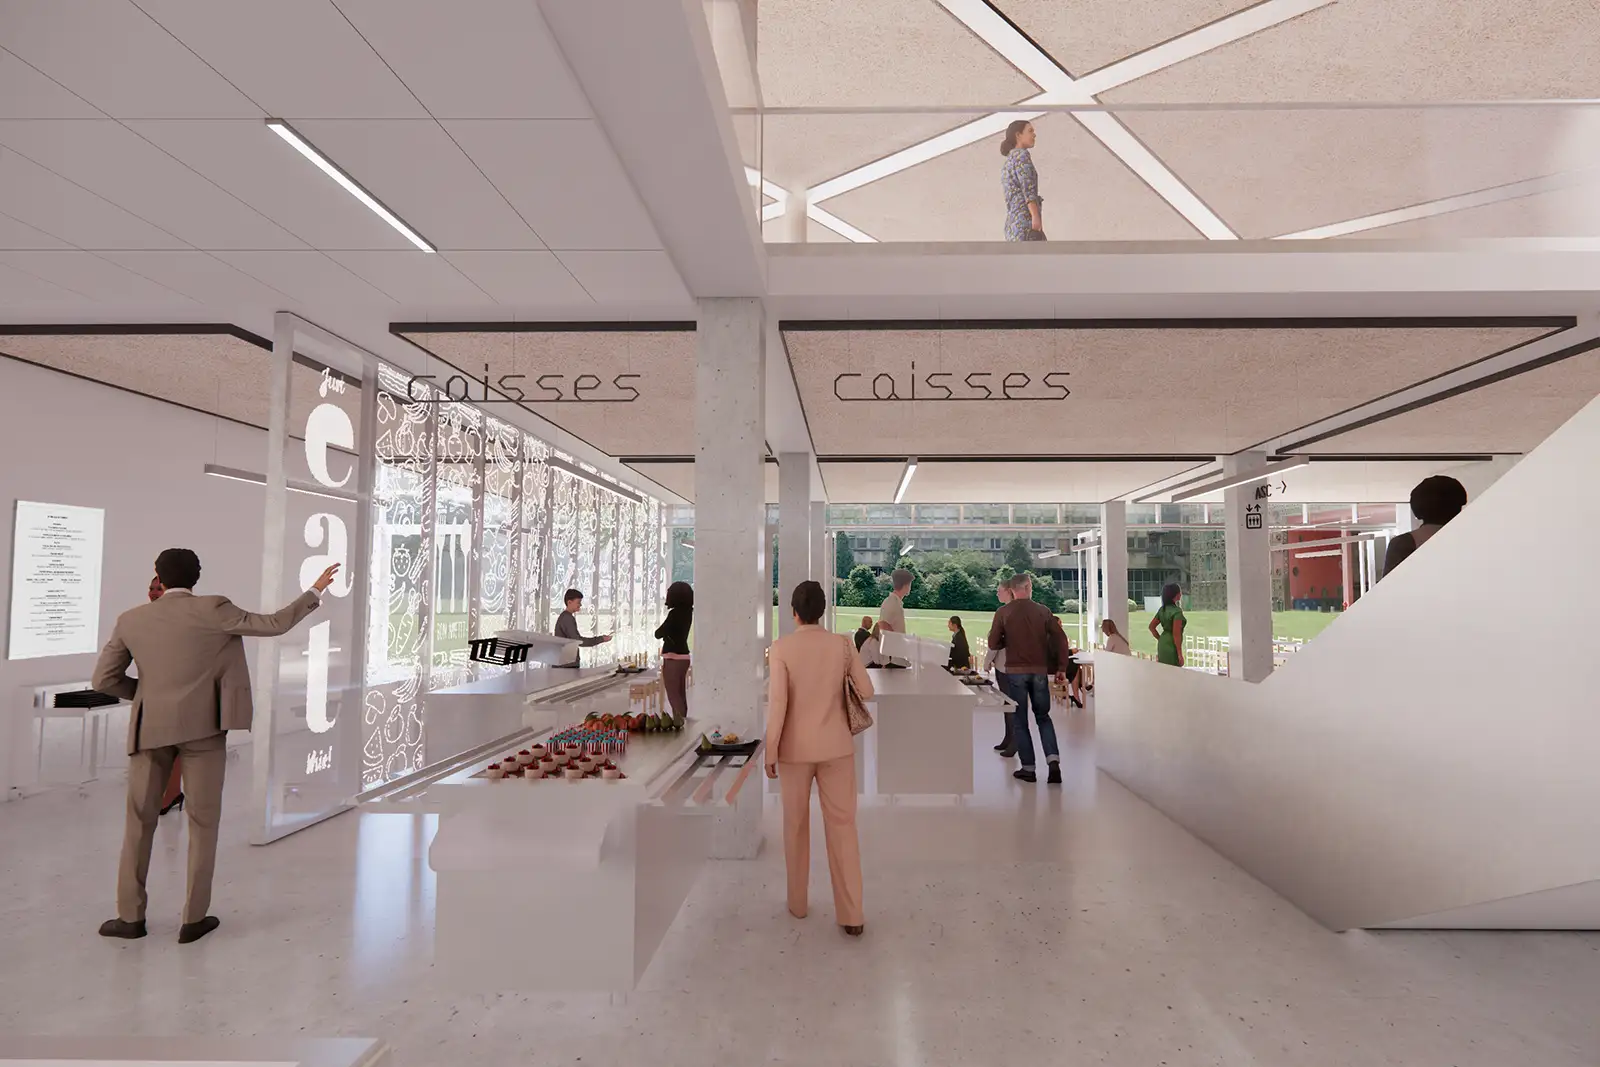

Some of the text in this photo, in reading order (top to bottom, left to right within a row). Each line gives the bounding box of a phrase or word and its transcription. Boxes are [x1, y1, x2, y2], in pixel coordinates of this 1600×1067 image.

[408, 363, 640, 402] caisses
[834, 361, 1070, 401] caisses
[1255, 484, 1272, 500] ASC
